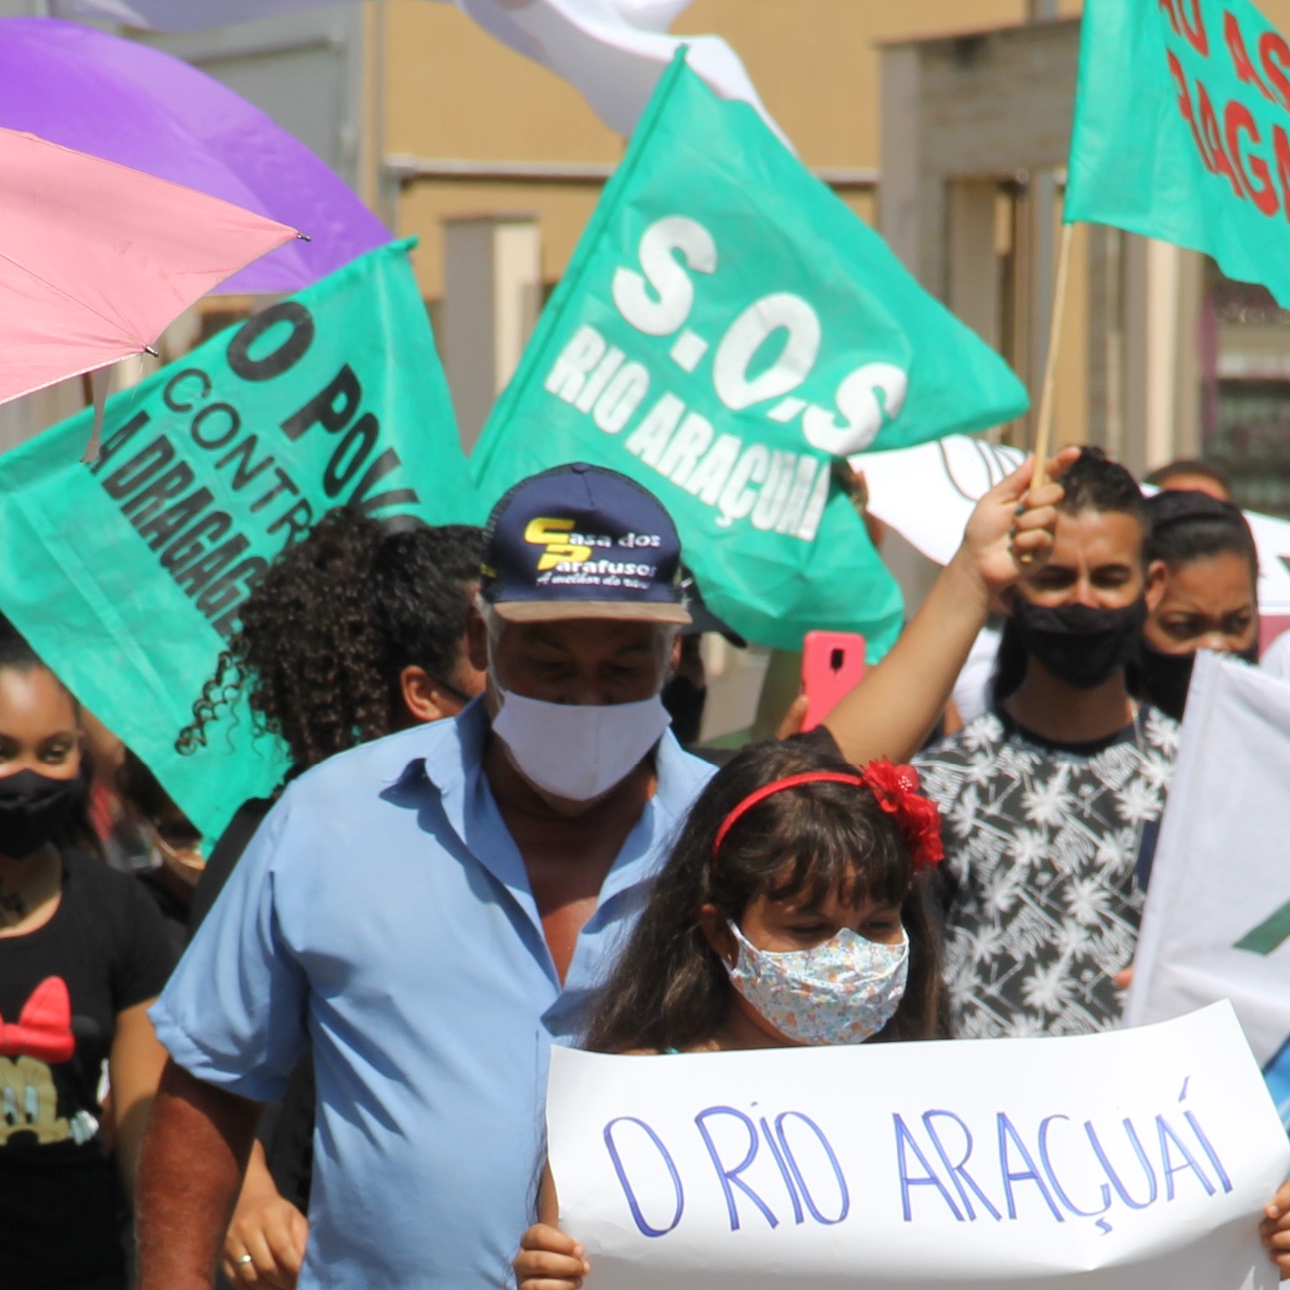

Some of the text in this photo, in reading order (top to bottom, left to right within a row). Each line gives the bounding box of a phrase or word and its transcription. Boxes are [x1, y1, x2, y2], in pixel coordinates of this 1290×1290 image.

[226, 300, 316, 383] O
[544, 323, 651, 434] RIO
[524, 516, 661, 548] Casa dos
[602, 1076, 1233, 1238] O RIO ARAÇUAÍ
